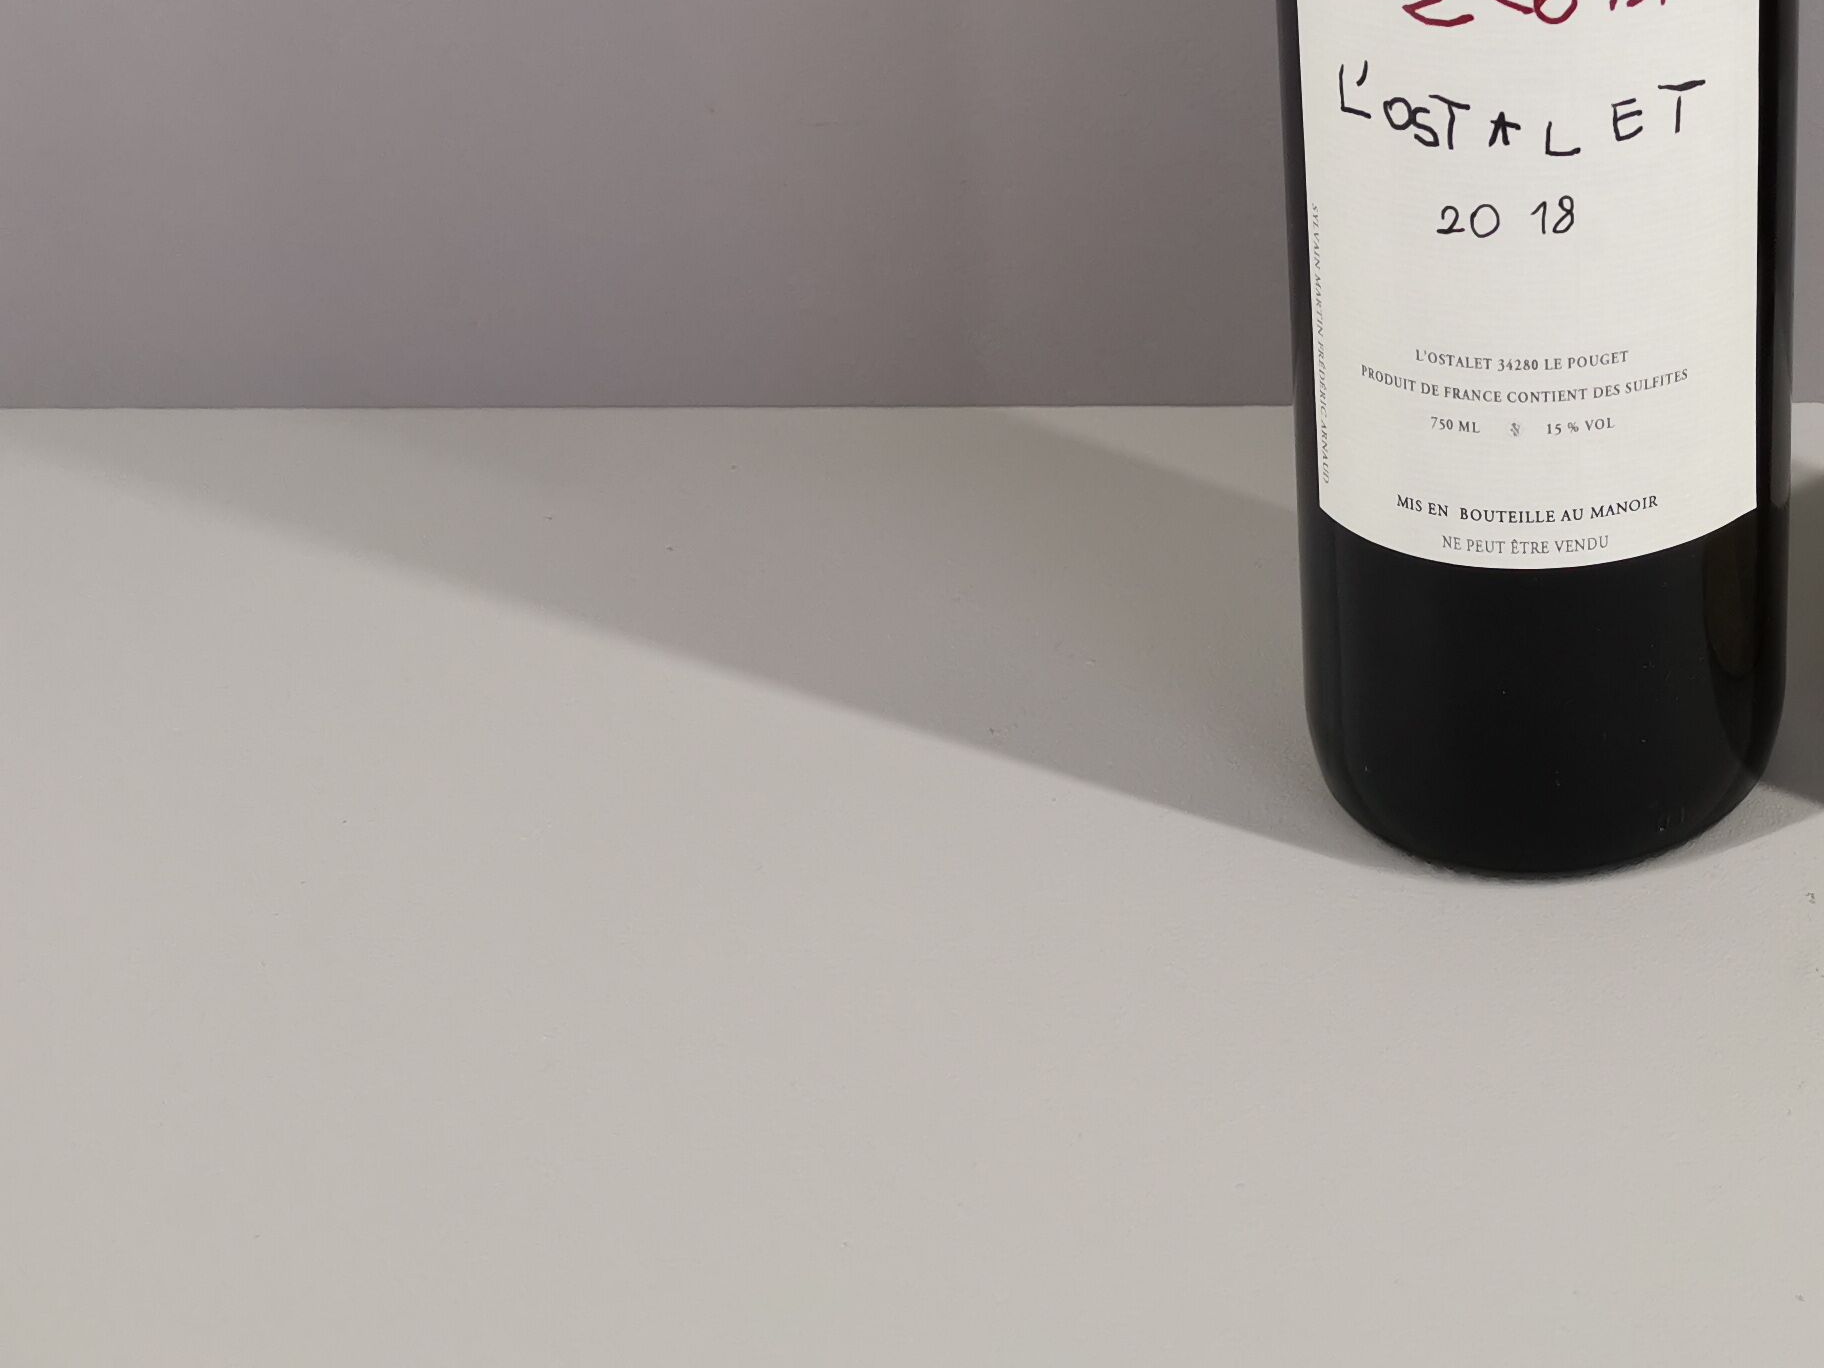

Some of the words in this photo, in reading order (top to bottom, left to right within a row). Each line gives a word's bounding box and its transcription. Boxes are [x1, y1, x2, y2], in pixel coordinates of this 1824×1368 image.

[1338, 59, 1707, 158] L'OSTALET
[1311, 202, 1321, 270] SYLVAIN
[1314, 274, 1324, 338] MARTIN
[1415, 348, 1493, 371] L'OSTALET
[1496, 358, 1539, 372] 34280
[1544, 357, 1563, 371] LE
[1567, 349, 1629, 370] POUGET
[1361, 363, 1417, 392] PRODUIT
[1420, 381, 1440, 397] DE
[1443, 385, 1503, 403] FRANCE
[1506, 387, 1589, 404] CONTIENT
[1593, 383, 1621, 399] DES
[1624, 367, 1688, 395] SULFITES
[1430, 415, 1454, 431] 750
[1457, 419, 1481, 434] ML
[1546, 423, 1562, 436] 15
[1566, 421, 1580, 433] %
[1584, 417, 1616, 432] VOL
[1320, 417, 1331, 485] ARNAUD
[1396, 493, 1423, 513] MIS
[1427, 501, 1449, 518] EN
[1459, 506, 1556, 524] BOUTEILLE
[1559, 507, 1584, 523] AU
[1589, 495, 1659, 520] MANOIR
[1441, 534, 1462, 551] NE
[1466, 538, 1506, 555] PEUT
[1510, 538, 1550, 555] ÊTRE
[1553, 534, 1609, 553] VENDU
